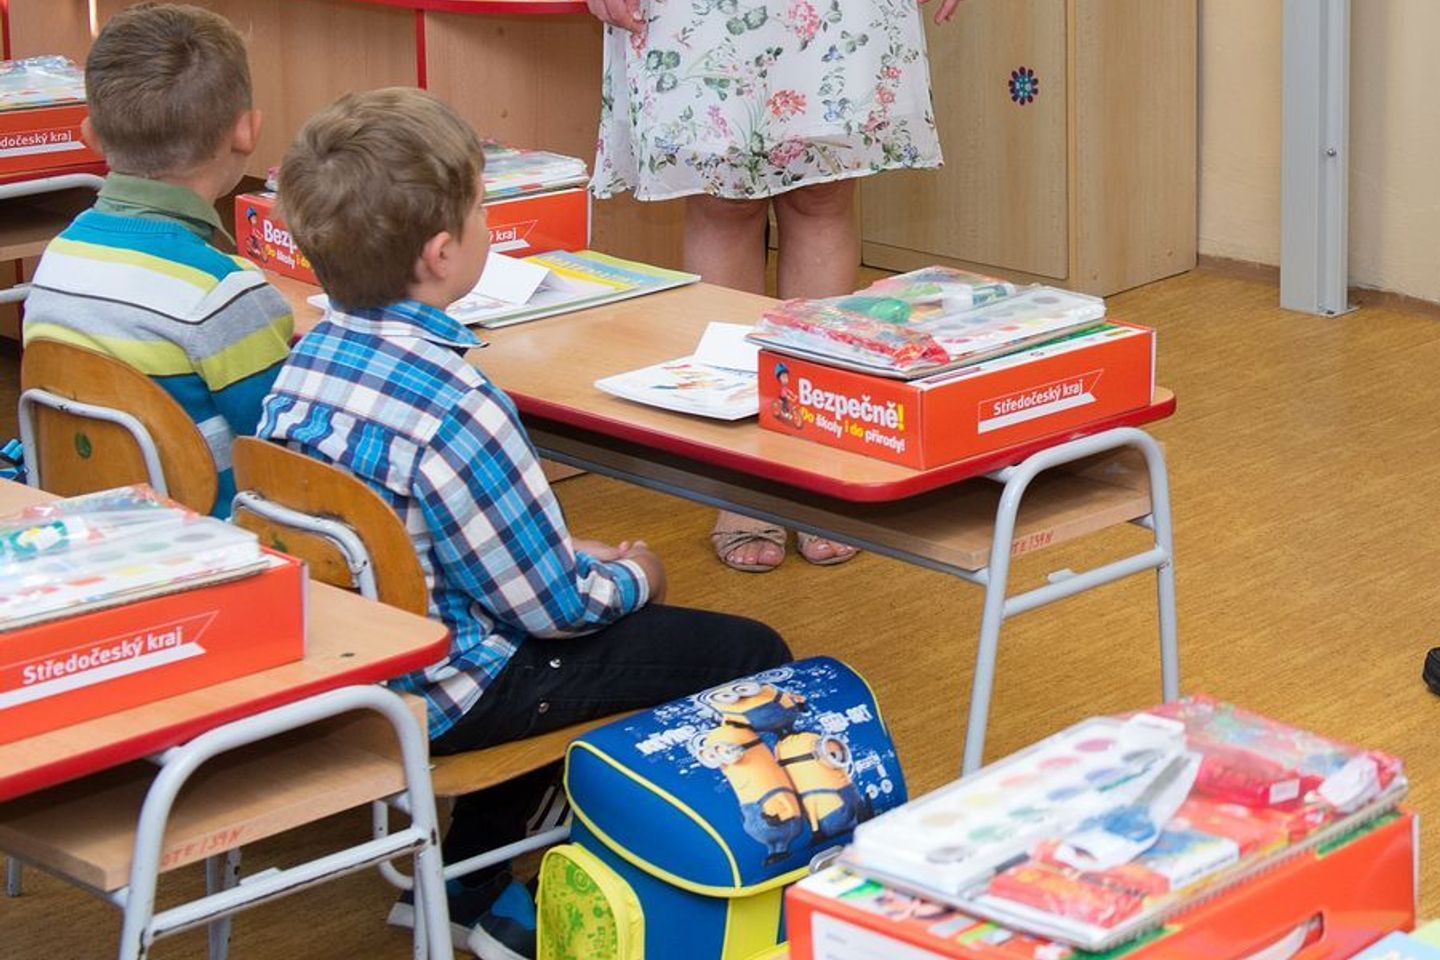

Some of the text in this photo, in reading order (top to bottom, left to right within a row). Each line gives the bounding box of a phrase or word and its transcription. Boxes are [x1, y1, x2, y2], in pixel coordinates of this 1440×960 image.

[0, 130, 72, 148] dočeský kraj
[496, 227, 517, 242] kraj
[798, 378, 905, 431] Bezpečně!
[993, 378, 1084, 417] Středočeský kraj
[22, 625, 182, 685] Středočeský kraj
